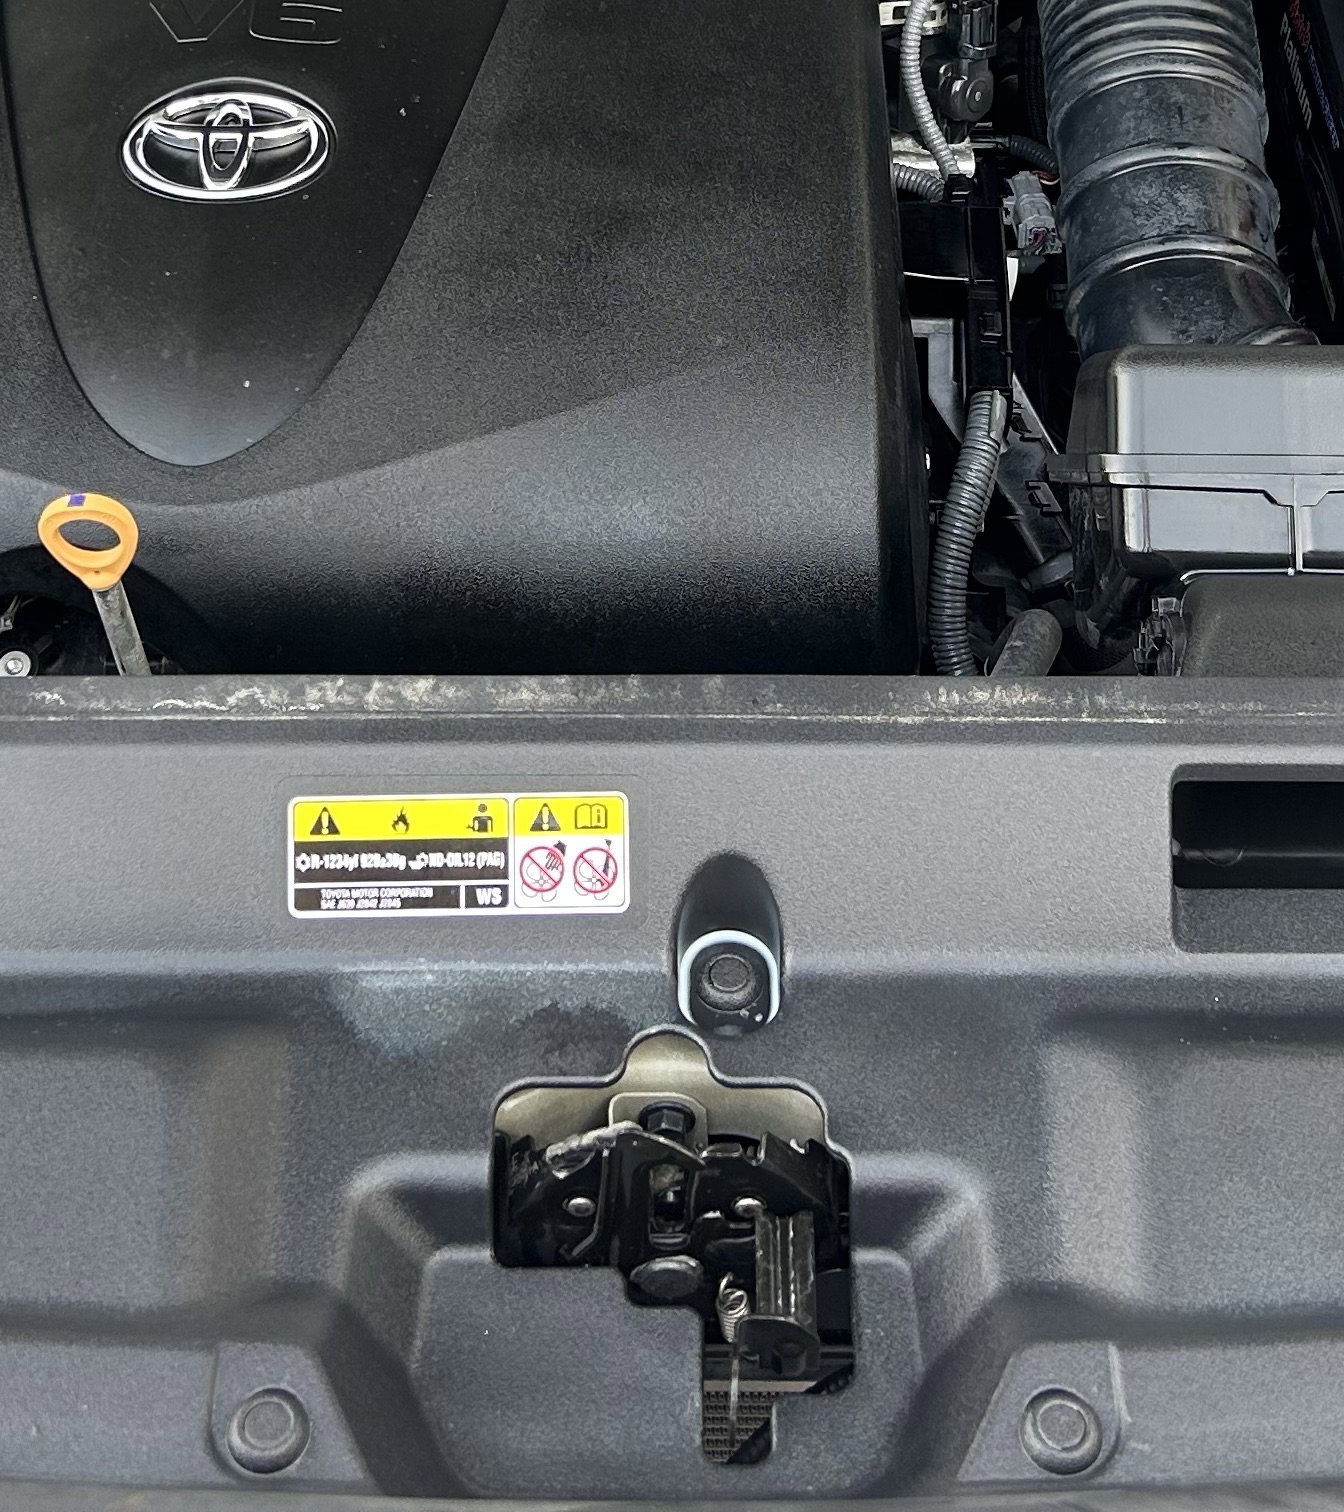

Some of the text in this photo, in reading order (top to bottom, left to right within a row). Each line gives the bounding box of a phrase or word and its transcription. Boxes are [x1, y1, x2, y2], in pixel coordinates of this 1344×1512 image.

[1280, 11, 1312, 129] Platinum
[380, 887, 434, 899] CORPORATION
[476, 887, 503, 906] WS
